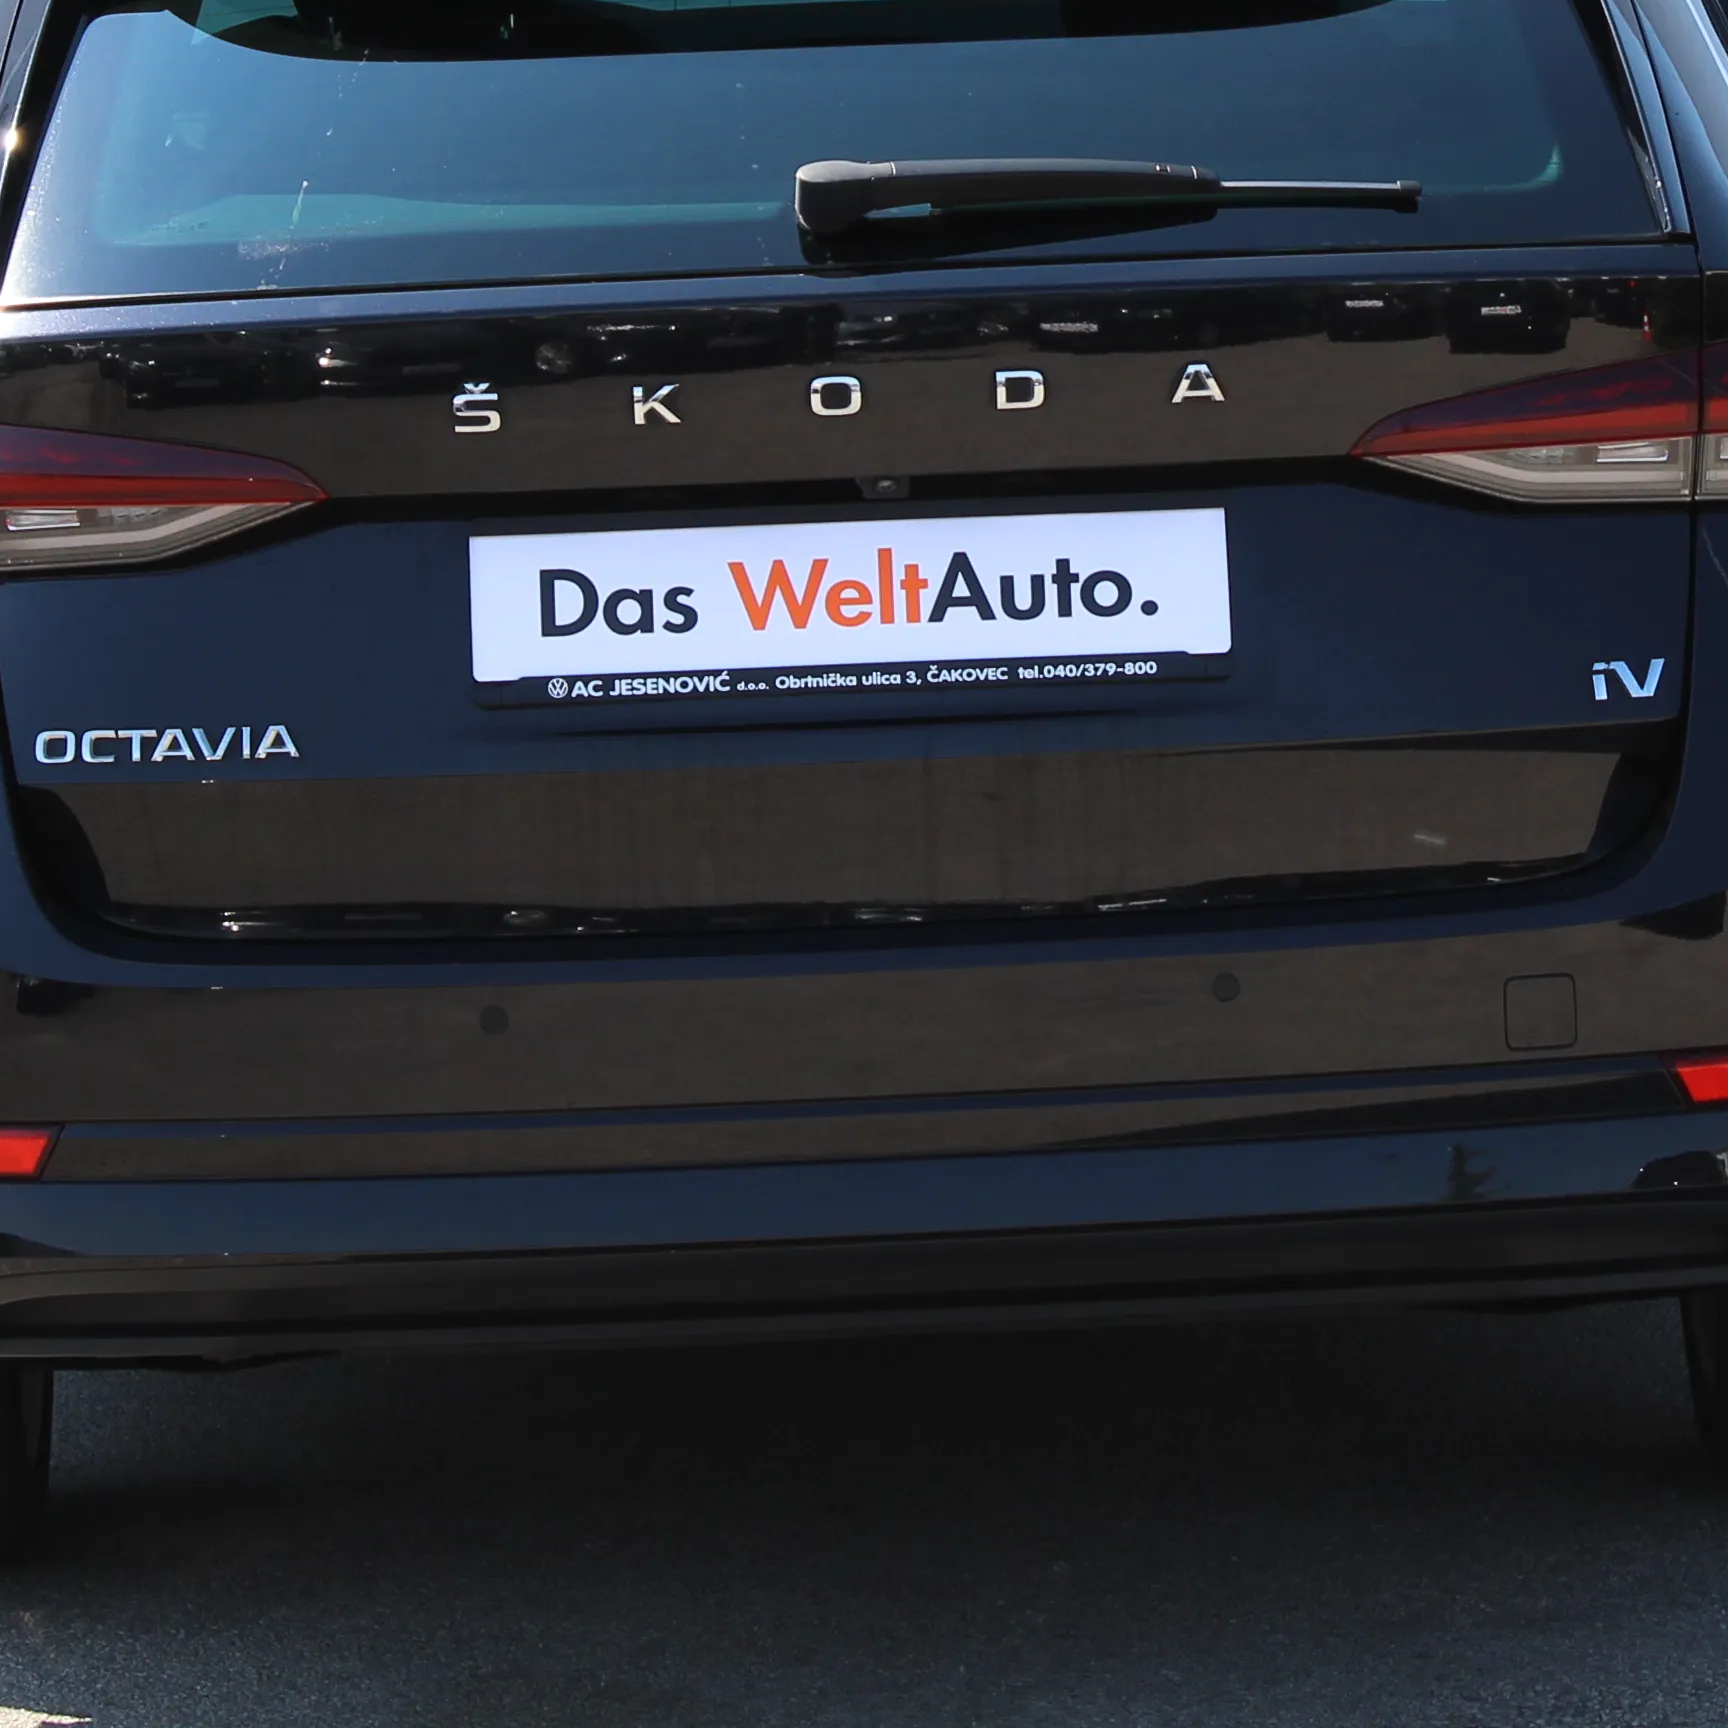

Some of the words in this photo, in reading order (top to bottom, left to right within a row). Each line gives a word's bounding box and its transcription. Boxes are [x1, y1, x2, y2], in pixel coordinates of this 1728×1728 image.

[539, 568, 699, 638] Das
[728, 547, 1159, 631] WeltAuto.
[571, 679, 604, 698] AC
[608, 670, 731, 696] JESENOVIĆ
[736, 680, 770, 691] d.o.o.
[775, 672, 858, 689] Obrtnička
[861, 671, 902, 686] ulica
[905, 670, 922, 686] 3,
[926, 664, 1009, 683] ČAKOVEC
[34, 724, 300, 764] OCTAVIA
